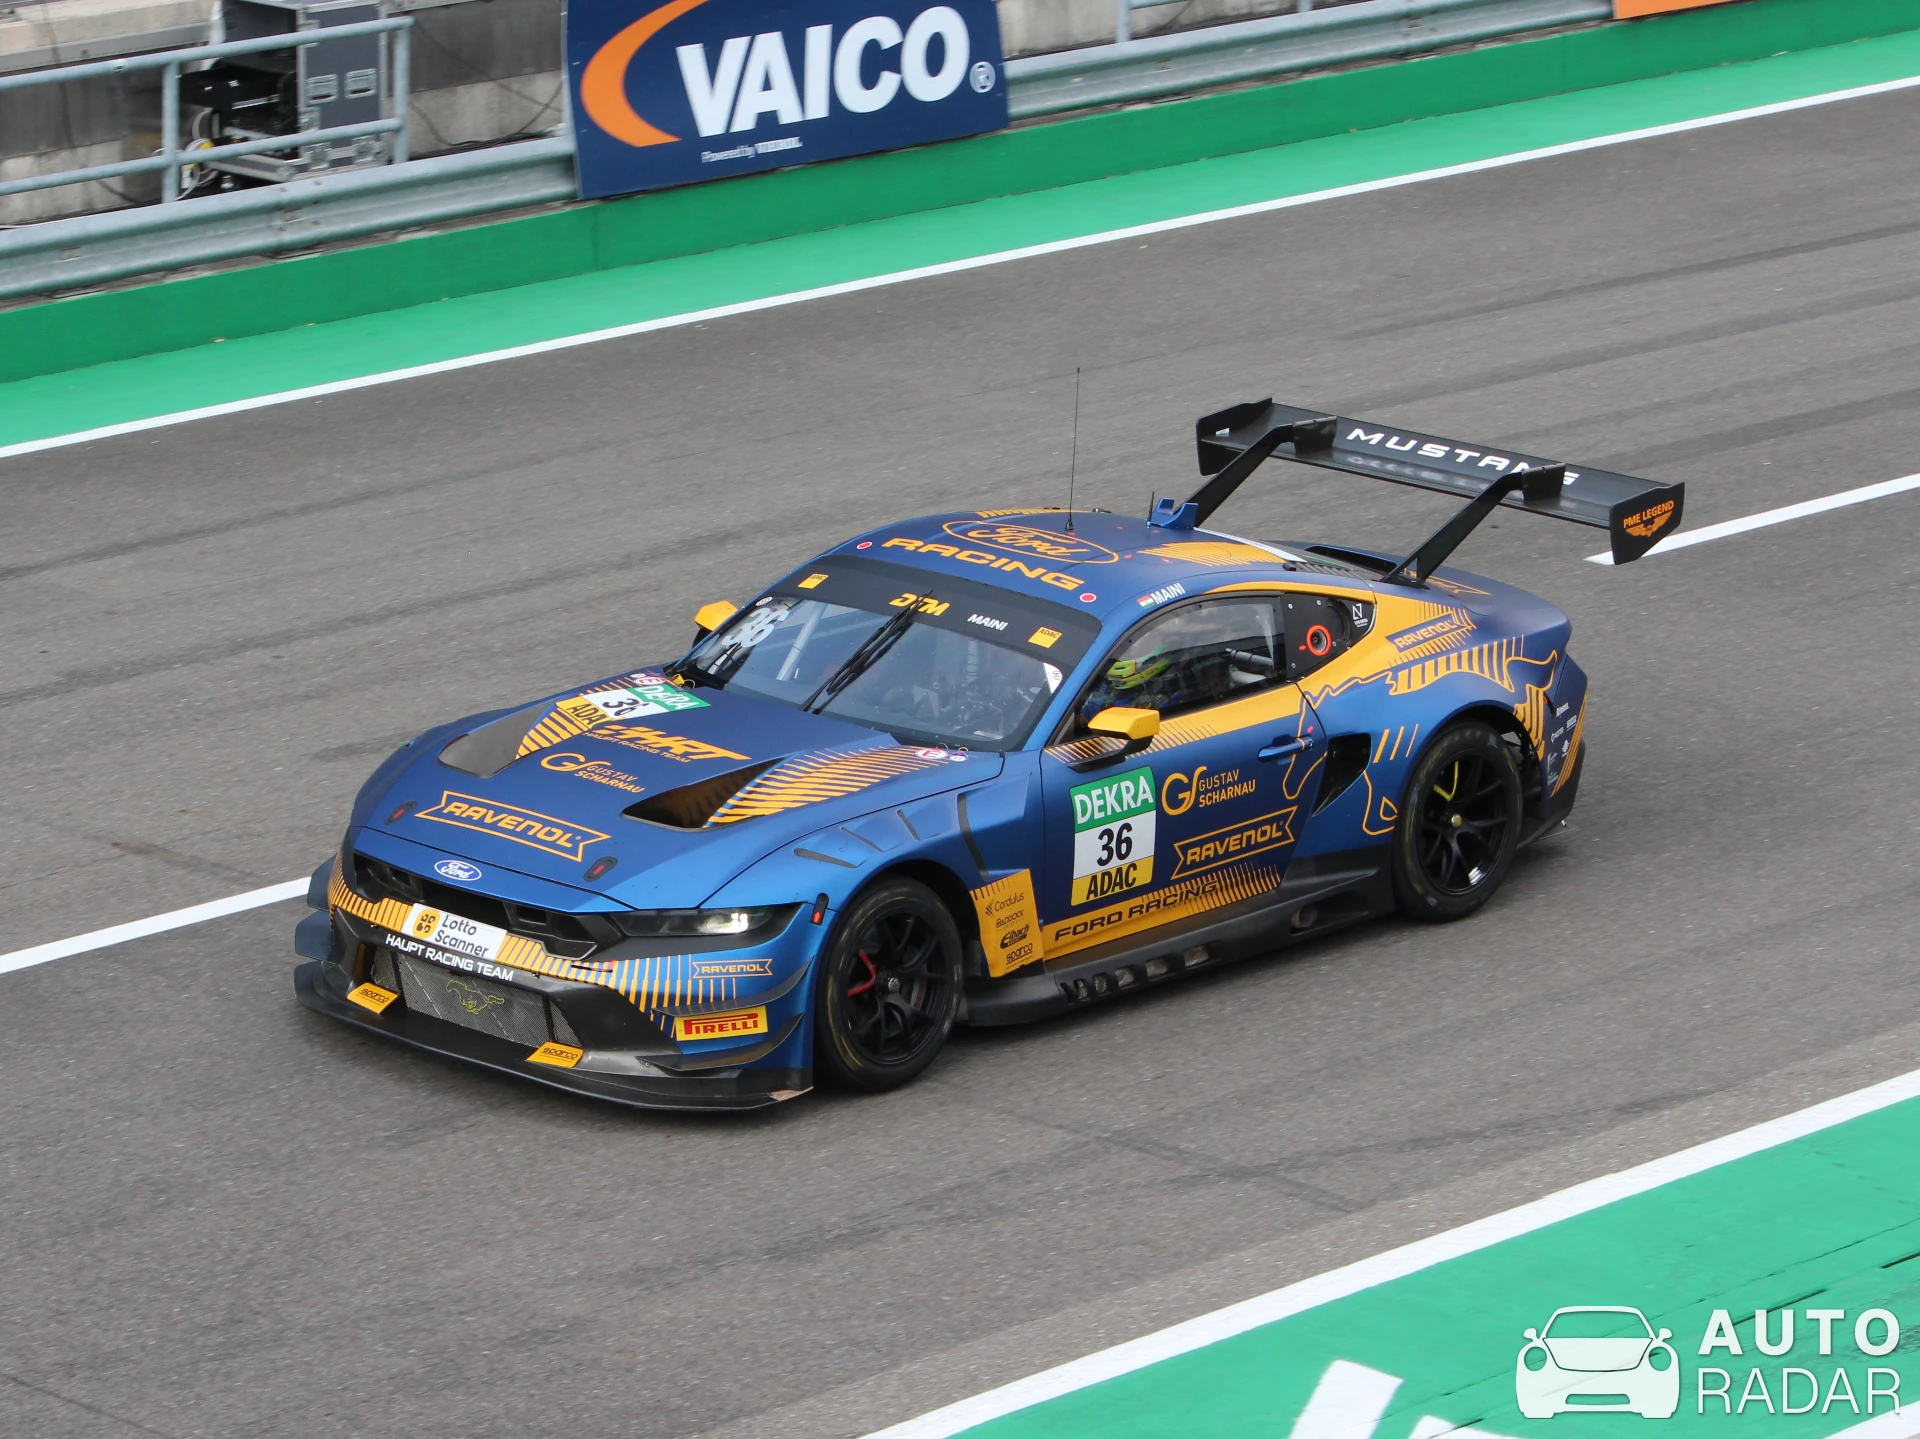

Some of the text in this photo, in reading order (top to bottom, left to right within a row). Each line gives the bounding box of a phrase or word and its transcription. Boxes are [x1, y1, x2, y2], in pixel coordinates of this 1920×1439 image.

[1623, 500, 1675, 529] PME LEGEND
[967, 527, 1091, 557] Ford
[882, 537, 1085, 591] RACING
[1150, 582, 1186, 605] MAINI
[721, 607, 790, 648] 36
[967, 613, 1009, 631] MAINI
[1038, 628, 1060, 639] ADAC
[1394, 619, 1458, 649] RAVENOL
[583, 732, 692, 764] HAUPT RACING TEAM
[573, 770, 645, 794] SCHARNAU
[586, 764, 639, 782] GUSTAV
[1199, 768, 1240, 792] GUSTAV
[1073, 775, 1154, 825] DEKRA
[1199, 779, 1256, 808] SCHARNAU
[442, 801, 574, 848] RAVENOL
[1096, 822, 1133, 867] 36
[1186, 823, 1283, 866] RAVENOL
[440, 861, 476, 881] Ford
[1086, 862, 1138, 901] ADAC
[994, 892, 1025, 912] Cordulus
[1055, 878, 1219, 942] FORD RACING
[442, 914, 477, 936] Lotto
[385, 933, 515, 981] HAUPT RACING TEAM
[435, 930, 489, 958] Scanner
[1006, 942, 1033, 964] sparco
[701, 963, 765, 974] RAVENOL
[683, 1012, 759, 1036] PIRELLI
[541, 1047, 579, 1061] sparco
